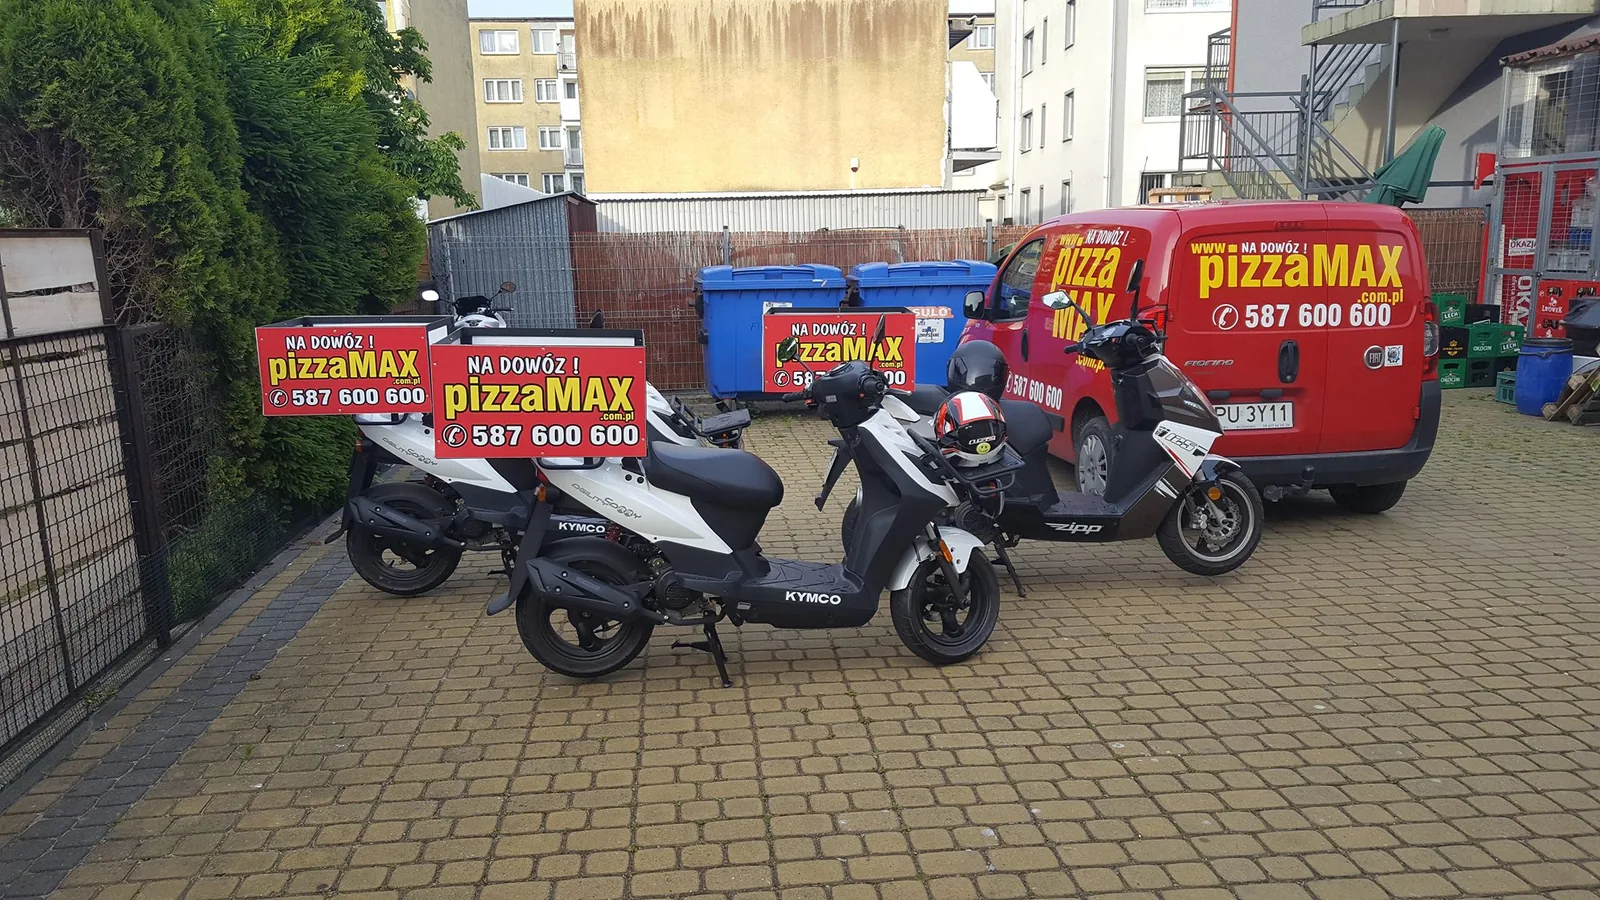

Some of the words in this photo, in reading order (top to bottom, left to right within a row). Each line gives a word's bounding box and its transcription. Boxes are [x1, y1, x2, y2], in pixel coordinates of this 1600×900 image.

[1084, 229, 1097, 245] NA
[1095, 226, 1124, 246] DOWÓZ
[1510, 240, 1537, 248] OKAZJ
[1191, 242, 1226, 254] www
[1241, 242, 1257, 253] NA
[1260, 239, 1300, 253] DOWÓZ
[1050, 237, 1121, 293] pizza
[1199, 243, 1404, 299] pizzaMAX
[1357, 289, 1404, 305] .com.pl
[913, 308, 948, 317] SULO
[1245, 304, 1290, 328] 587
[1299, 304, 1342, 327] 600
[1349, 303, 1391, 327] 600
[1444, 311, 1459, 320] LECH
[791, 323, 809, 336] NA
[812, 320, 857, 336] DOWÓZ
[285, 335, 307, 350] NA
[311, 333, 363, 349] DOWÓZ
[1502, 342, 1517, 350] LECH
[468, 356, 494, 375] NA
[500, 354, 566, 375] DOWÓZ
[1369, 353, 1381, 363] FIAT
[268, 350, 420, 386] pizzaMAX
[393, 377, 421, 386] .com.pl
[292, 389, 331, 406] 587
[338, 388, 379, 405] 600
[385, 387, 425, 404] 600
[444, 376, 634, 420] pizzaMAX
[1013, 374, 1028, 397] 587
[1028, 379, 1045, 403] 600
[1045, 385, 1063, 411] 600
[600, 411, 634, 422] .com.pl
[1246, 404, 1286, 422] 3Y11
[472, 425, 522, 446] 587
[531, 425, 581, 446] 600
[590, 425, 639, 446] 600
[558, 522, 606, 533] KYMCO
[785, 591, 842, 605] KYMCO
